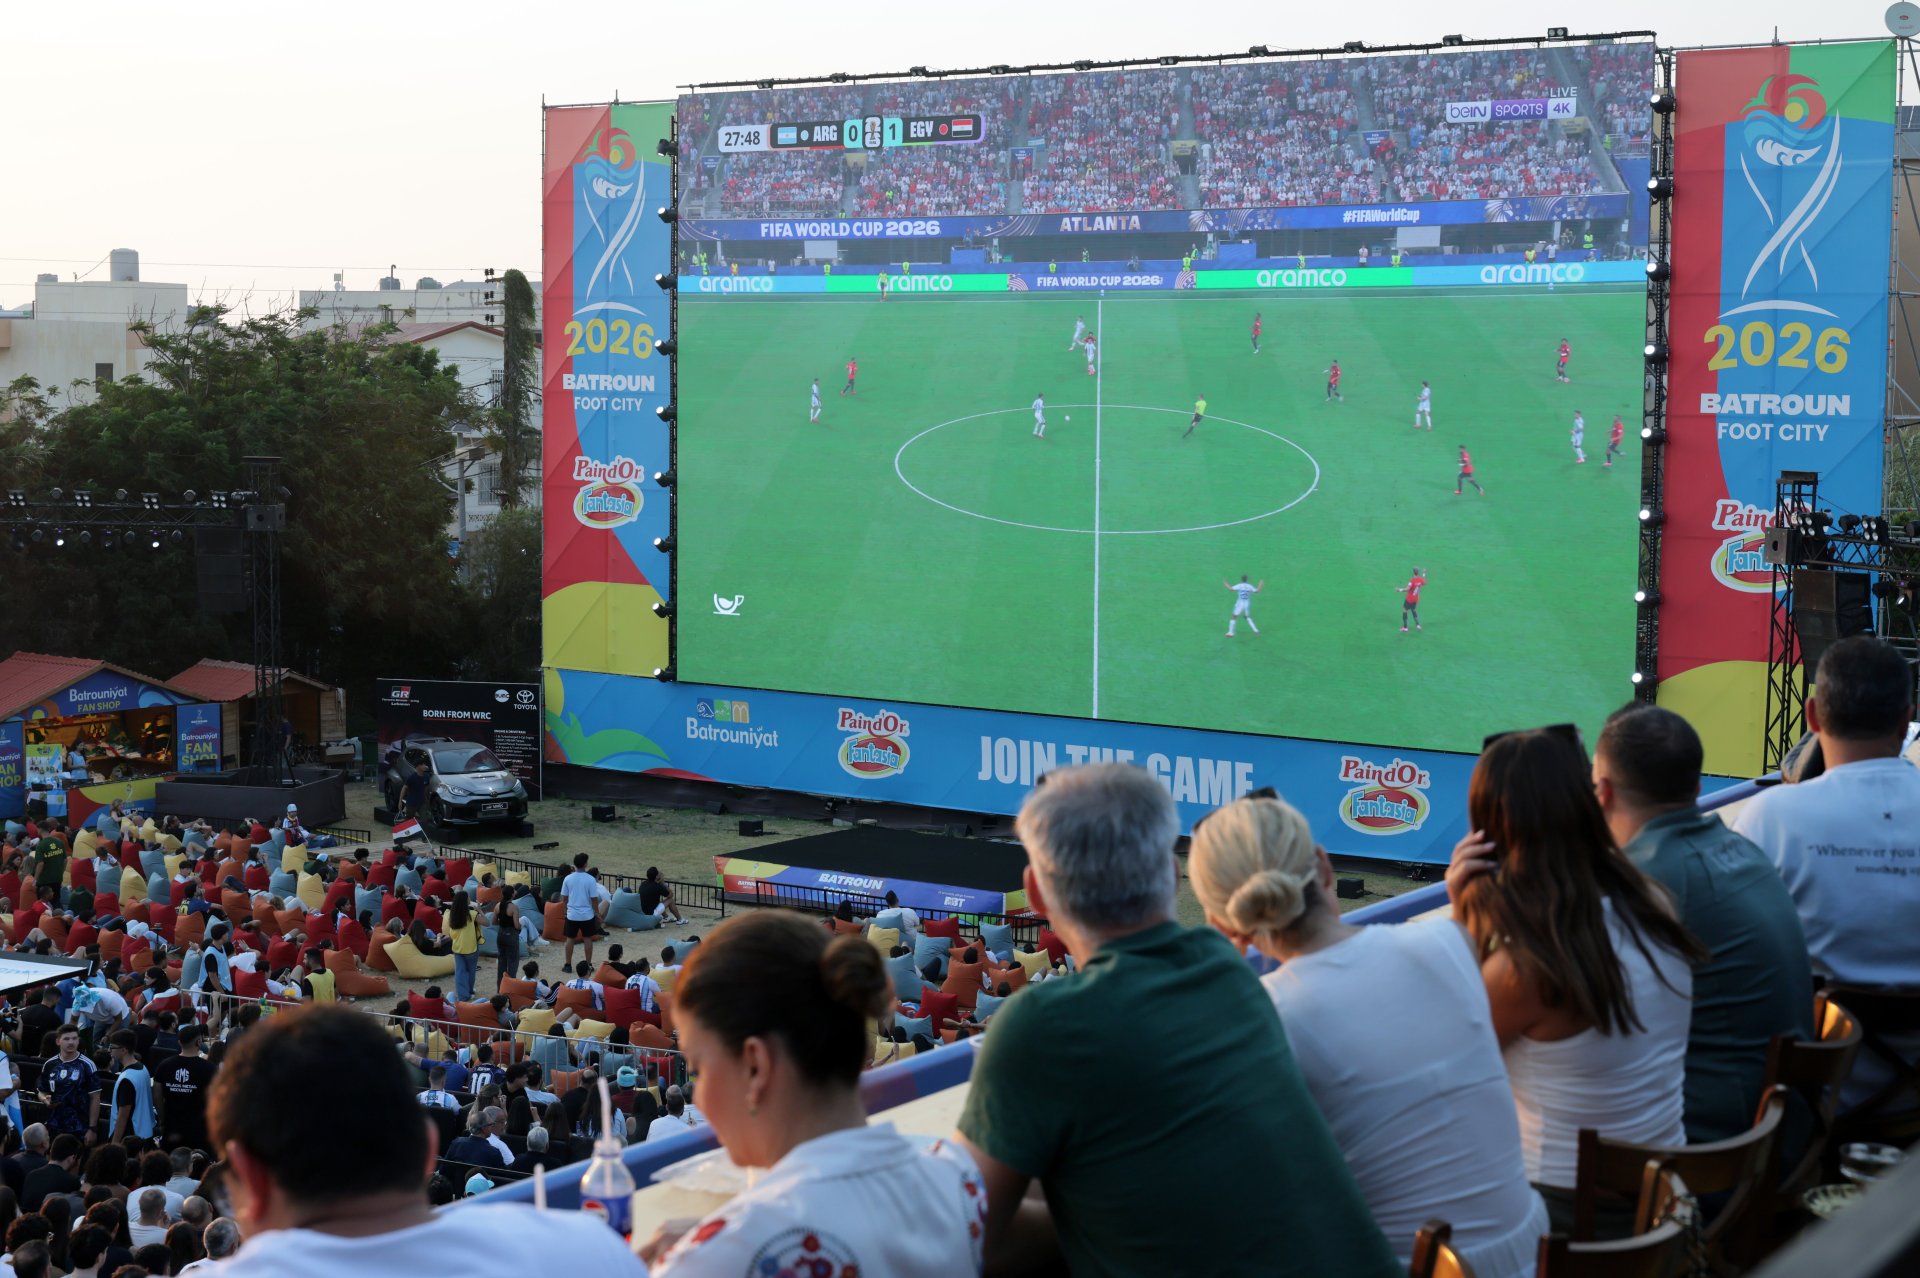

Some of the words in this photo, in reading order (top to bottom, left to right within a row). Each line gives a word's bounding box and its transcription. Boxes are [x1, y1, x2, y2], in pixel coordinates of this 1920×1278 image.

[1550, 87, 1577, 98] LIVE
[1495, 103, 1543, 116] SPORTS
[1553, 103, 1570, 114] 4K
[724, 131, 760, 146] 27:48
[813, 125, 838, 142] ARG
[848, 124, 858, 142] 0
[888, 122, 896, 141] 1
[910, 120, 934, 138] EGY
[1060, 215, 1141, 232] ATLANTA
[1342, 208, 1420, 223] #FIFAWorldCup
[760, 222, 793, 238] FIFA
[794, 221, 850, 237] WORLD
[852, 221, 883, 236] CUP
[886, 220, 941, 236] 2026
[1037, 276, 1059, 287] FIFA
[1061, 276, 1098, 287] WORLD
[1100, 275, 1121, 285] CUP
[1122, 275, 1160, 286] 2026
[1256, 269, 1347, 287] aramco
[1480, 262, 1585, 283] aramco
[698, 276, 774, 292] aramco
[563, 318, 655, 360] 2026
[1703, 321, 1851, 374] 2026
[562, 373, 655, 392] BATROUN
[574, 396, 608, 411] FOOT
[611, 397, 643, 412] CITY
[1700, 392, 1850, 416] BATROUN
[1717, 422, 1774, 441] FOOT
[1778, 423, 1830, 442] CITY
[582, 488, 634, 517] Fantasia
[391, 690, 409, 698] GR
[77, 703, 96, 713] FAN
[97, 700, 121, 711] SHOP
[422, 709, 446, 718] BORN
[447, 710, 471, 719] FROM
[472, 711, 492, 720] WRC
[185, 742, 213, 754] FAN
[847, 738, 900, 769] Fantasia
[978, 735, 1057, 787] JOIN
[1146, 753, 1254, 807] GAME
[1351, 790, 1418, 825] Fantasia
[818, 873, 884, 890] BATROUN
[175, 1067, 190, 1083] BMS
